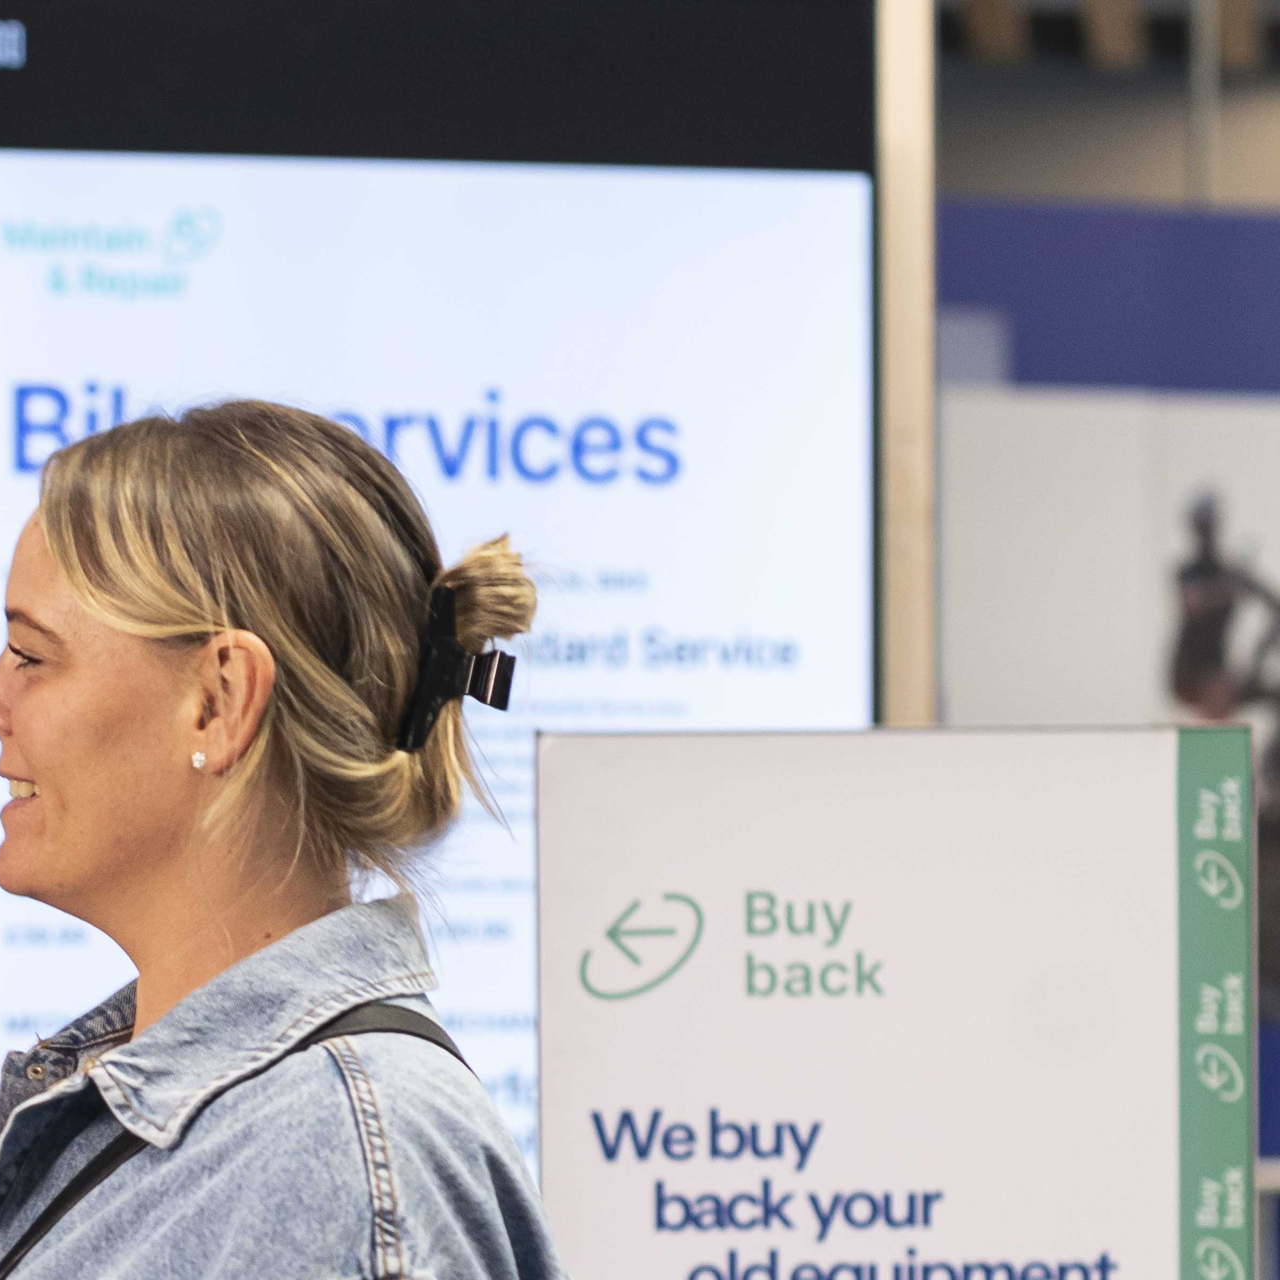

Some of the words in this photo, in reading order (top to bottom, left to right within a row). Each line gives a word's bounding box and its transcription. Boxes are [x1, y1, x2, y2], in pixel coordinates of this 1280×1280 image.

[15, 383, 124, 472] Bi
[336, 387, 679, 484] rvices
[643, 628, 798, 669] Service
[1194, 788, 1219, 840] Buy
[744, 891, 853, 948] Buy
[745, 951, 884, 997] back
[1195, 982, 1222, 1034] Buy
[591, 1110, 696, 1162] We
[709, 1107, 822, 1172] buy
[654, 1179, 793, 1232] back
[808, 1190, 943, 1242] your
[1196, 1177, 1222, 1229] Buy
